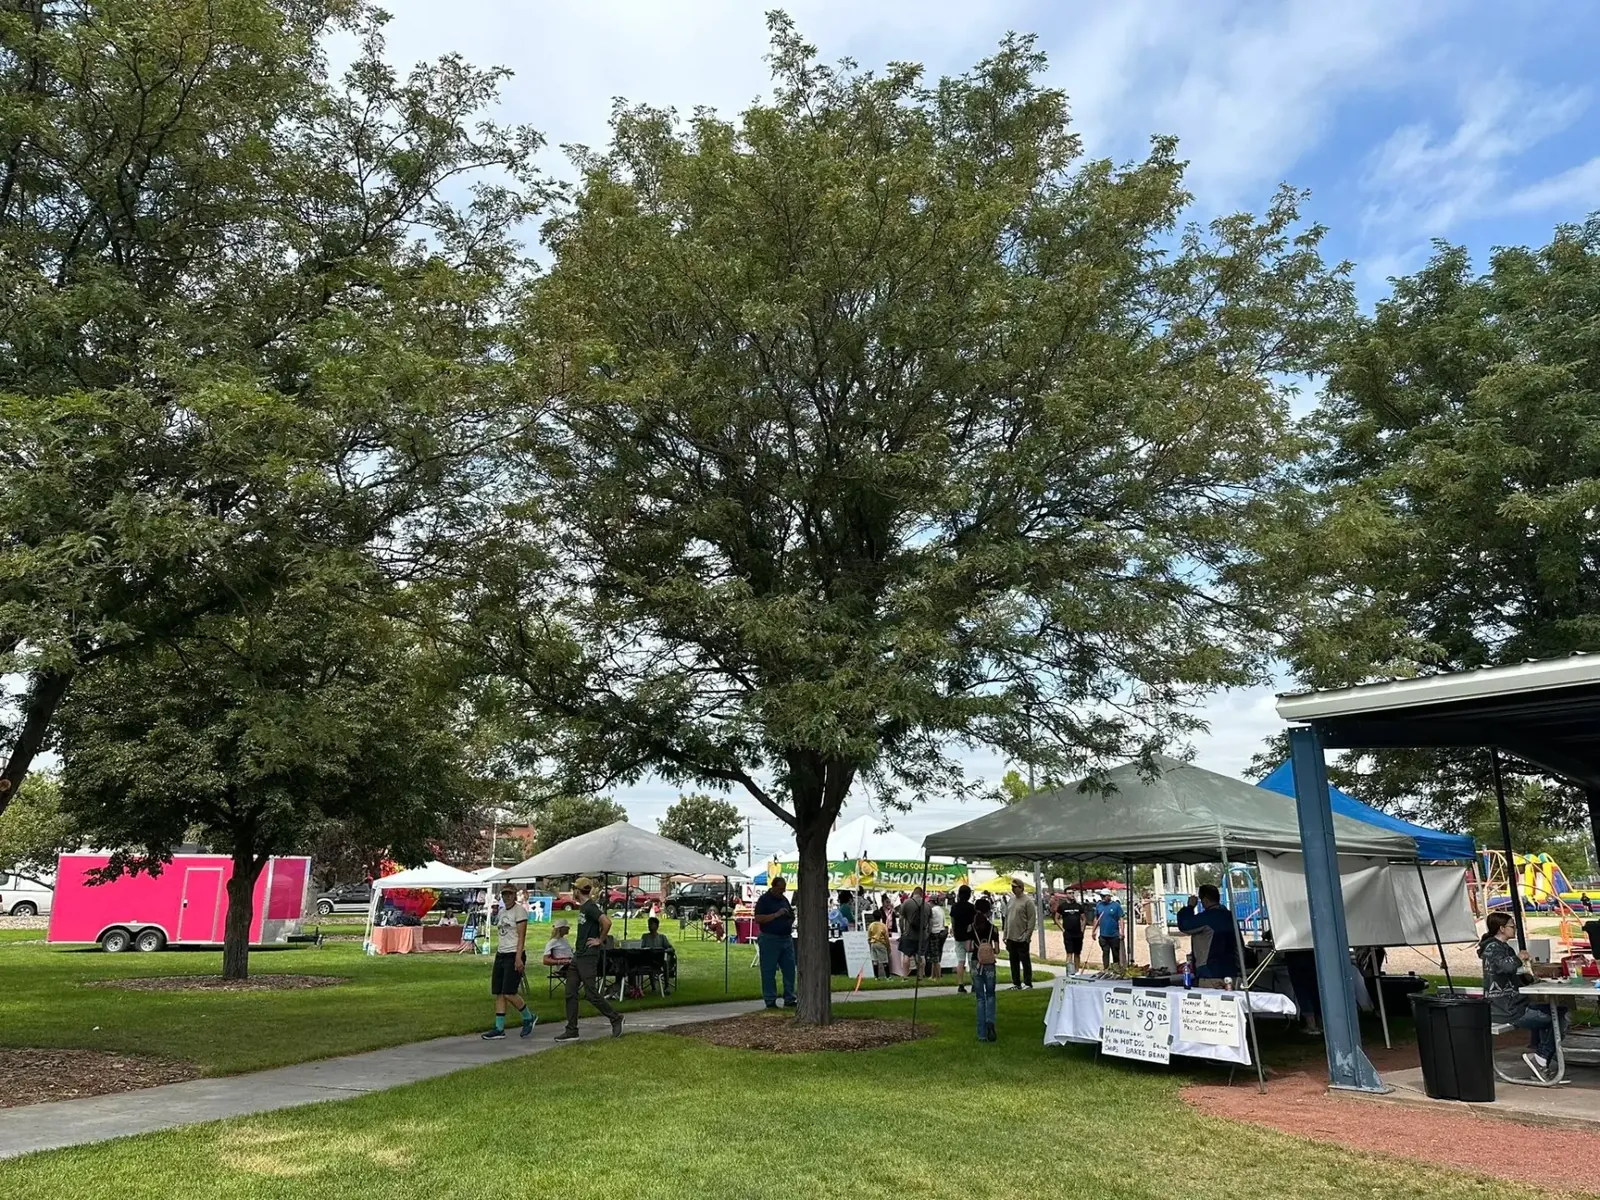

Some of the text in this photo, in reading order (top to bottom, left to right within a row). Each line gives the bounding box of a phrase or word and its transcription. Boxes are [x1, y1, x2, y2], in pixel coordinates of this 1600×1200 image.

[874, 870, 956, 887] LEMONADE
[1132, 994, 1167, 1011] KIWANIS
[1108, 1009, 1130, 1020] MEAL
